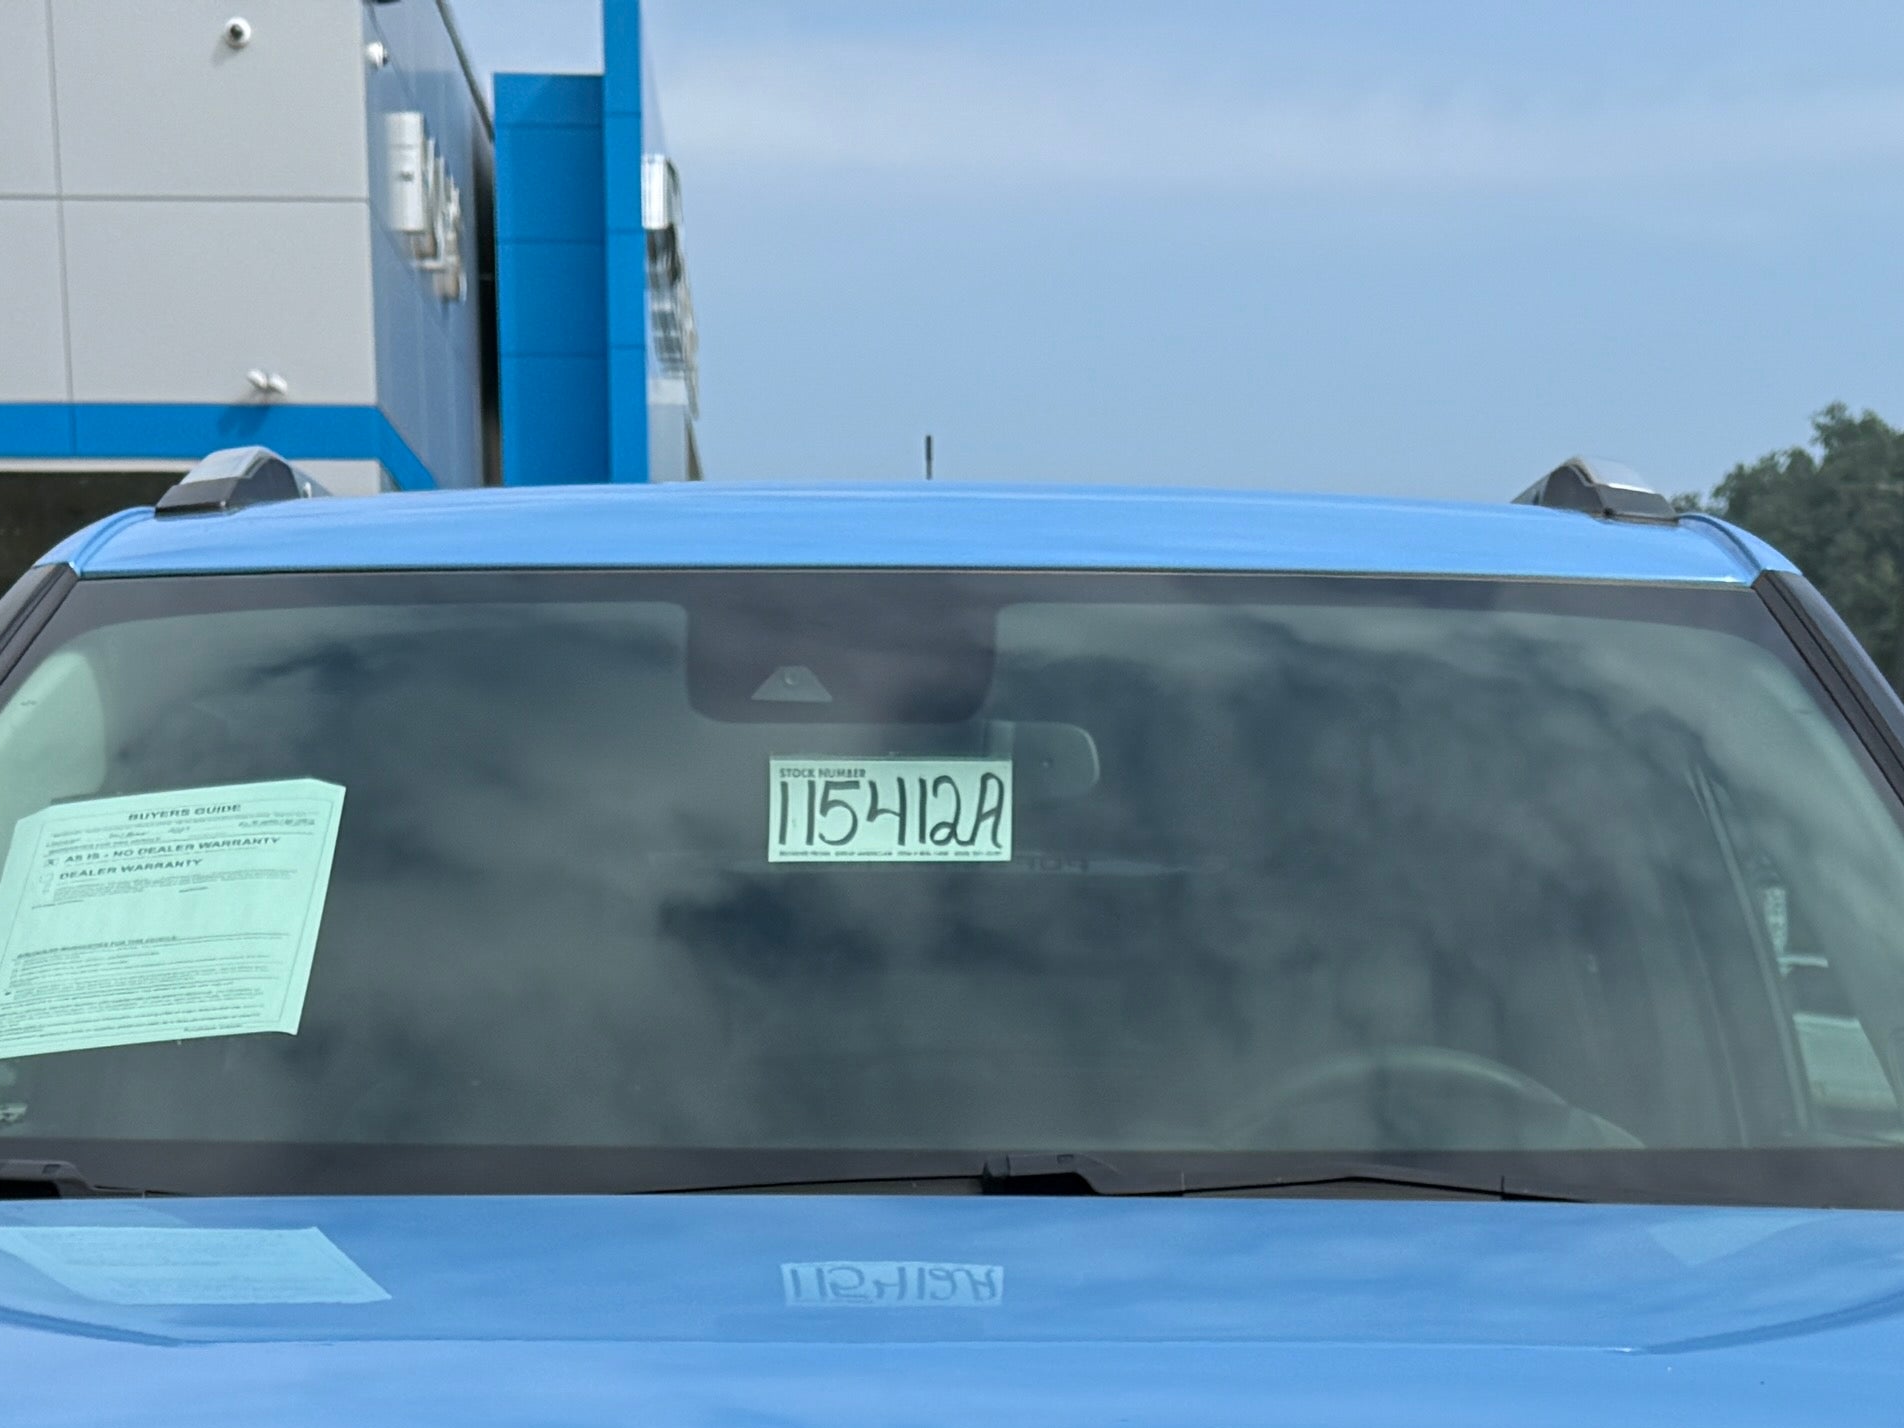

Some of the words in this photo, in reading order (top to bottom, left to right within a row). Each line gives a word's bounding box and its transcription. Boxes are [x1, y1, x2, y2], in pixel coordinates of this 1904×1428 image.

[779, 768, 816, 779] STOCK
[818, 768, 866, 779] NUMBER
[128, 808, 191, 821] BUYERS
[194, 804, 242, 816] GUIDE
[778, 772, 1004, 850] 115412A
[64, 855, 83, 863] AS
[87, 852, 100, 860] IS
[113, 849, 134, 857] NO
[137, 843, 195, 856] DEALER
[198, 836, 282, 850] WARRANTY
[59, 866, 117, 880] DEALER
[121, 859, 203, 873] WARRANTY
